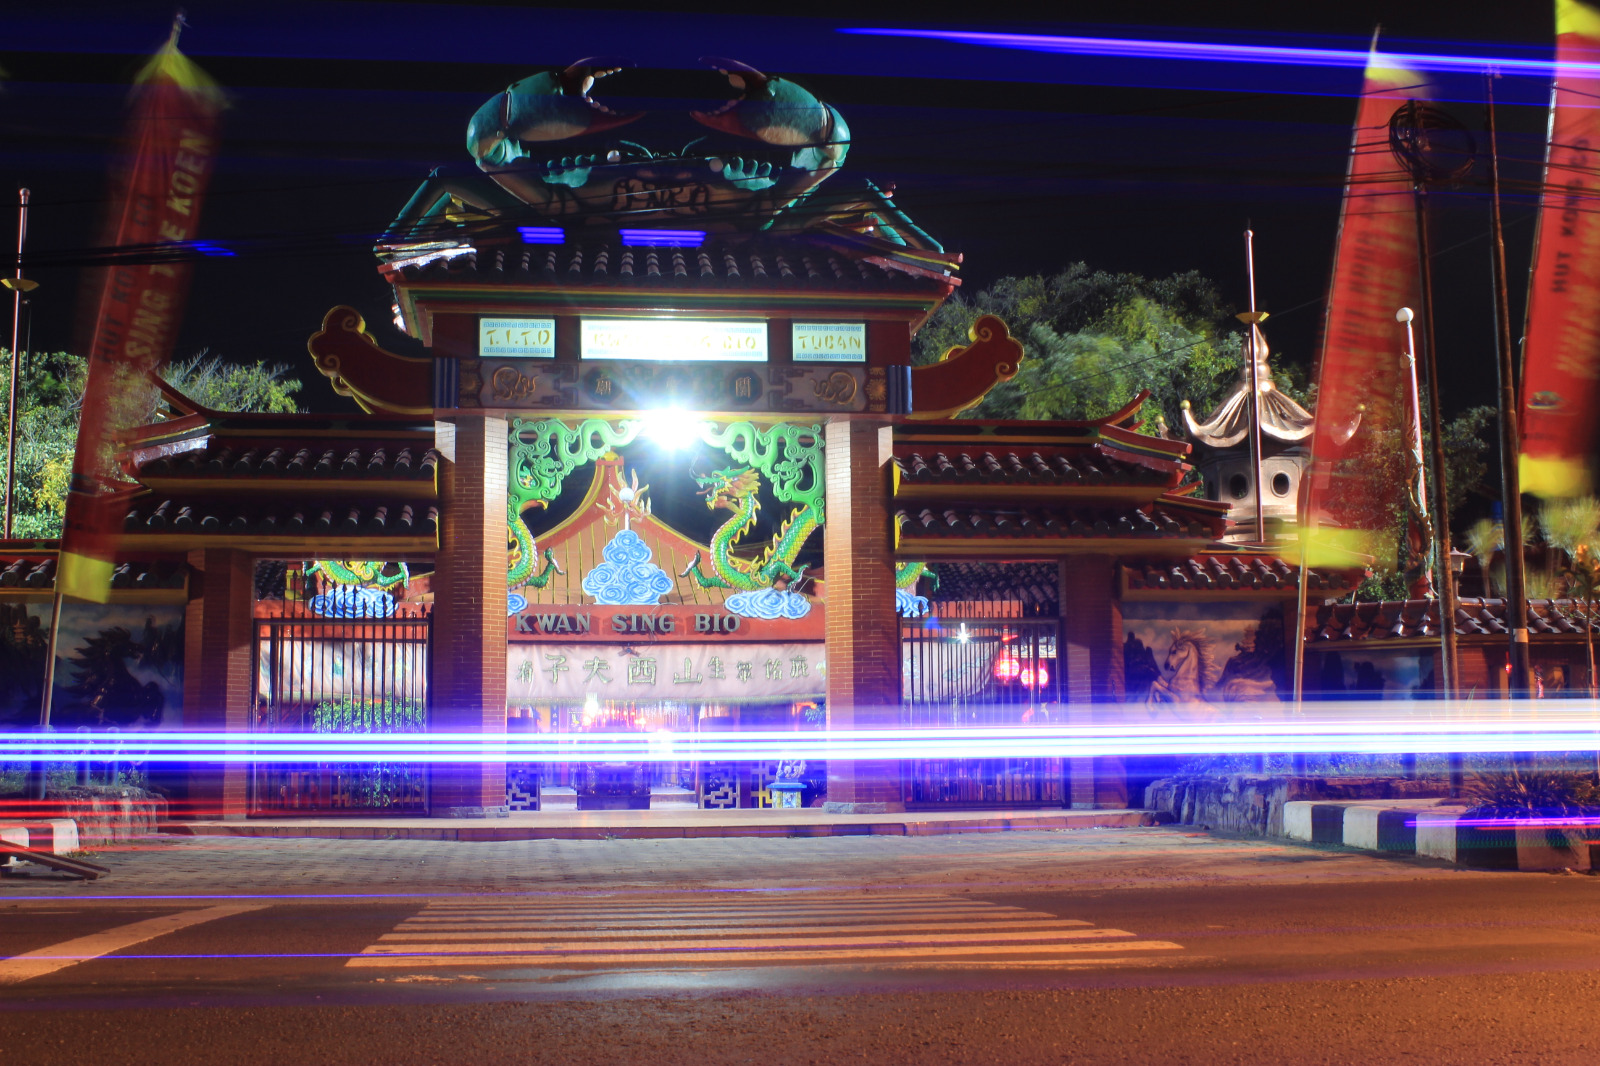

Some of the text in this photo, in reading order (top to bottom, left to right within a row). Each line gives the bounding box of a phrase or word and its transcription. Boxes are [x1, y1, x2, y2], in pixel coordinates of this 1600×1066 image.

[166, 128, 212, 216] KOEN
[798, 335, 862, 350] TUBAN
[514, 613, 741, 633] KWAN SING BIO
